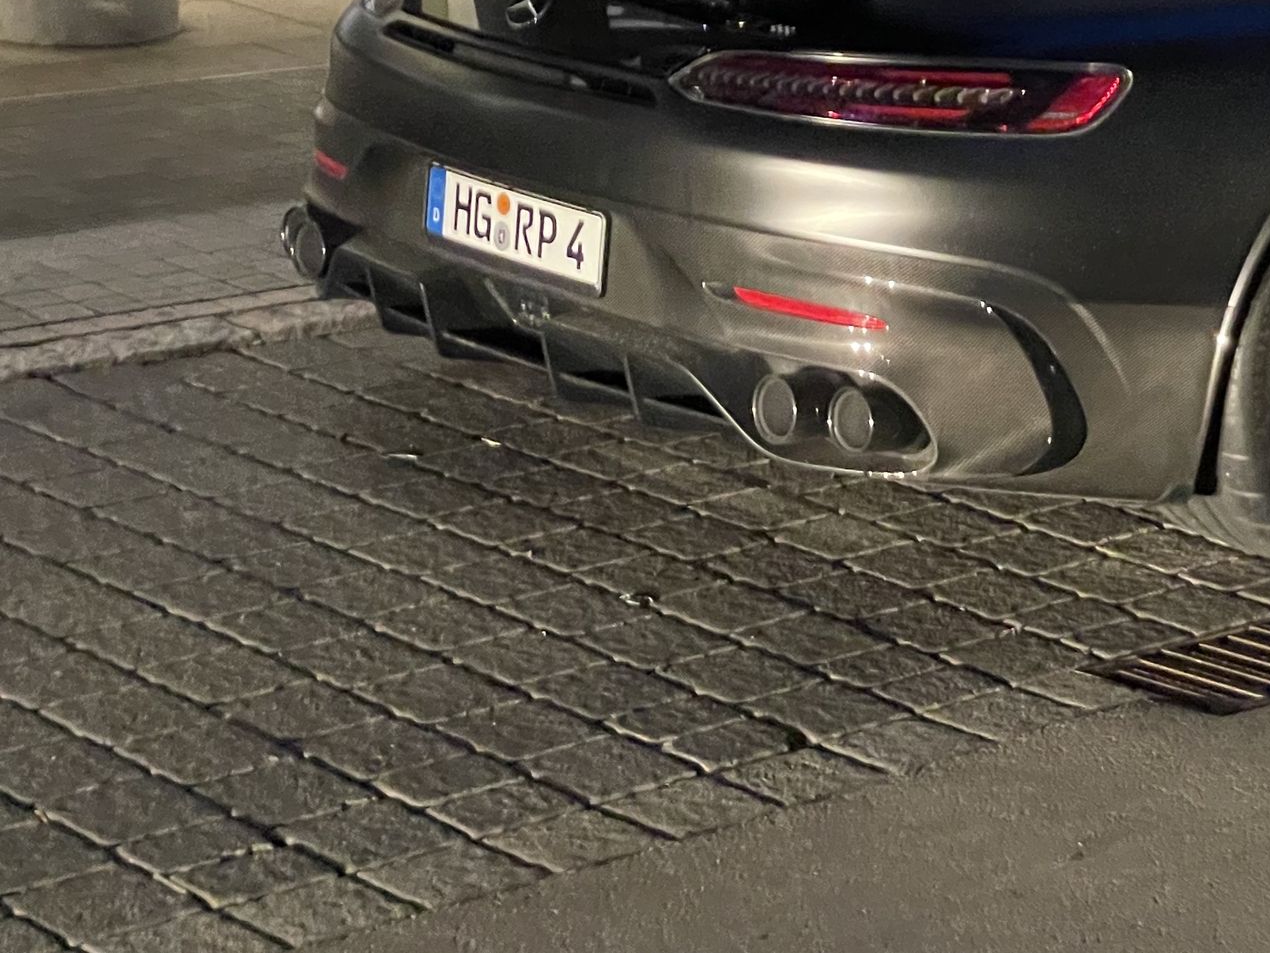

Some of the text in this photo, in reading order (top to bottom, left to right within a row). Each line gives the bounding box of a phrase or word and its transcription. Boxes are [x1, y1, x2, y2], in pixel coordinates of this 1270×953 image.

[454, 183, 585, 271] HG RP 4
